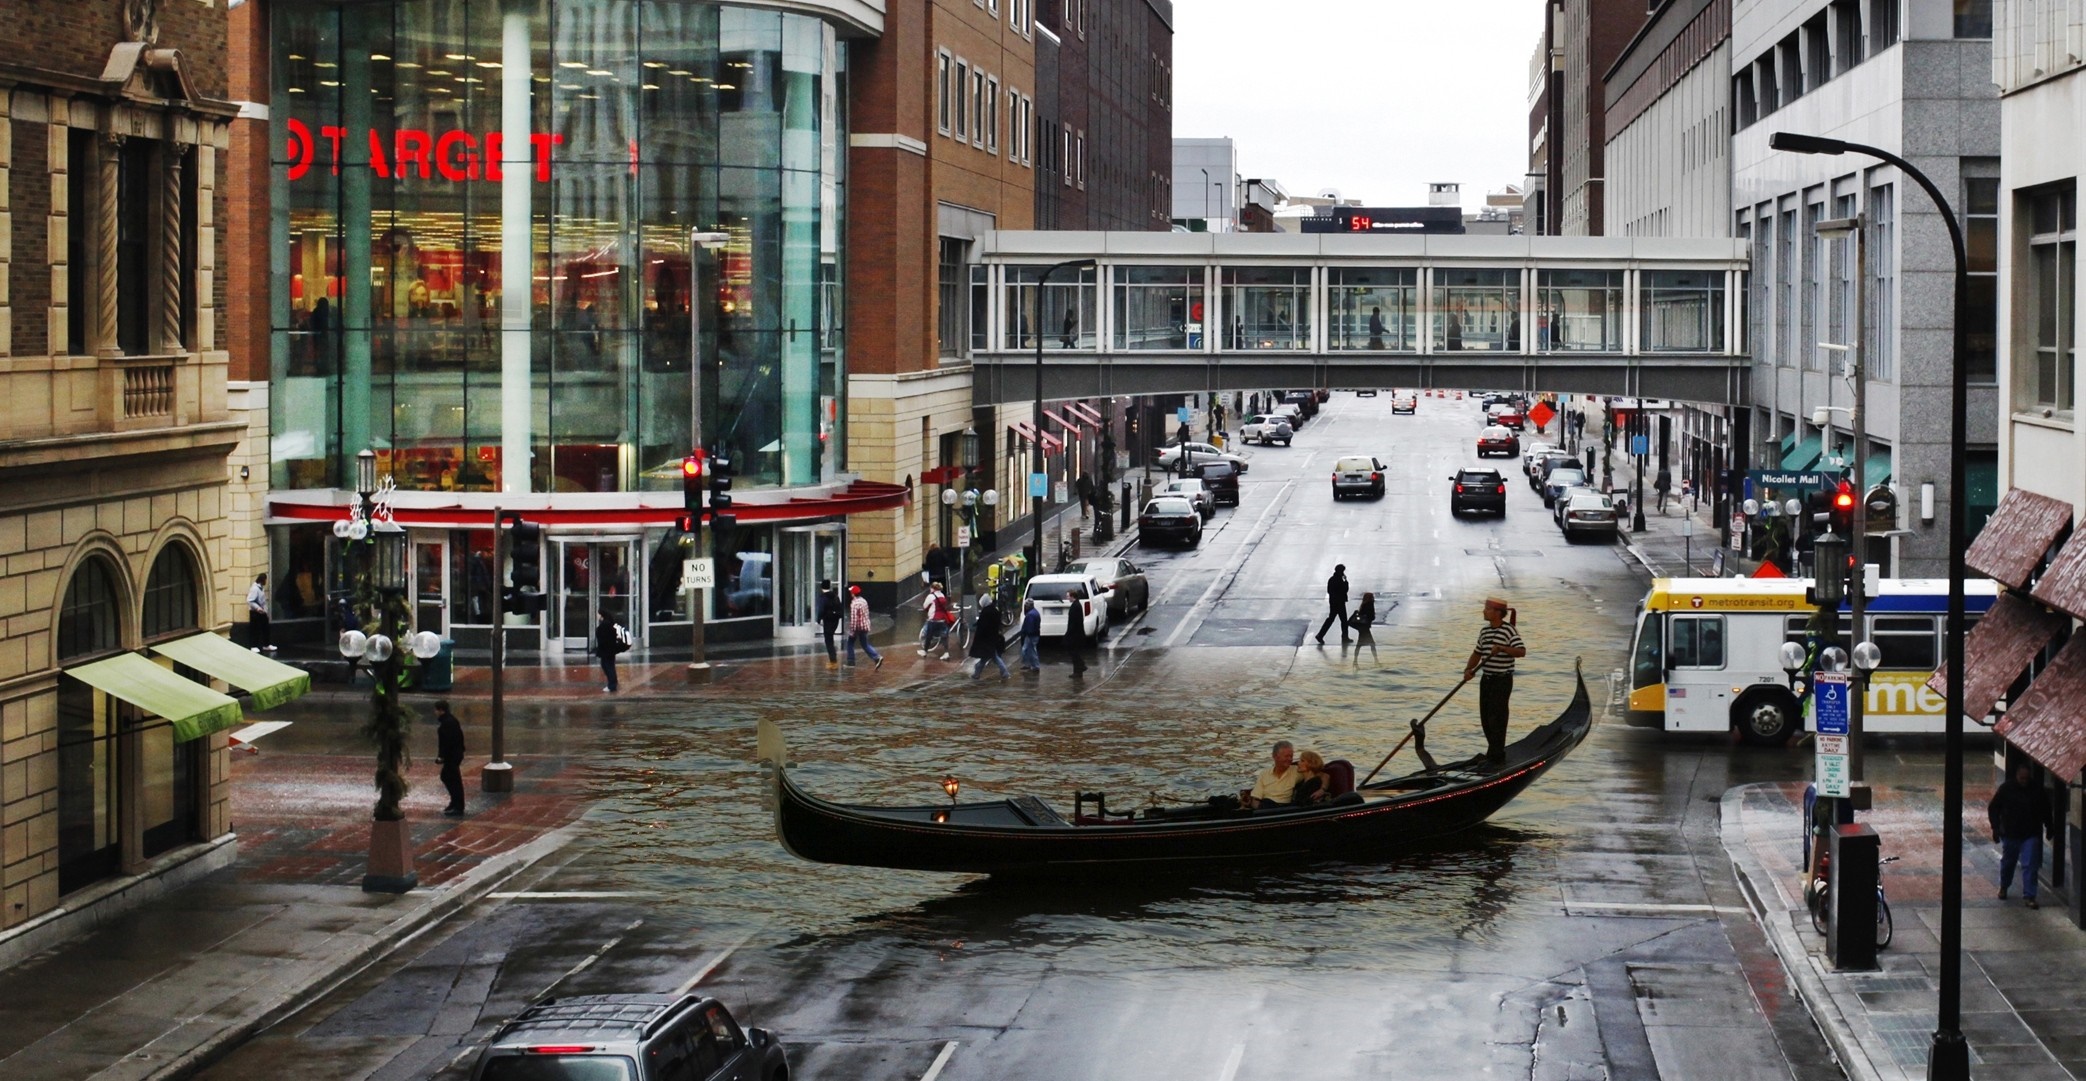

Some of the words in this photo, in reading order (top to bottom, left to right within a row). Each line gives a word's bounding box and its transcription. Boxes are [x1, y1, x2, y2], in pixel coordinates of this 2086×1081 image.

[321, 125, 564, 182] TARGET
[1352, 216, 1369, 230] 54
[1762, 474, 1796, 484] Nicollet
[1799, 475, 1819, 485] Mall
[691, 563, 706, 572] NO
[686, 576, 712, 584] TURNS
[1708, 598, 1795, 608] metrotransit.org
[1868, 683, 1946, 712] me
